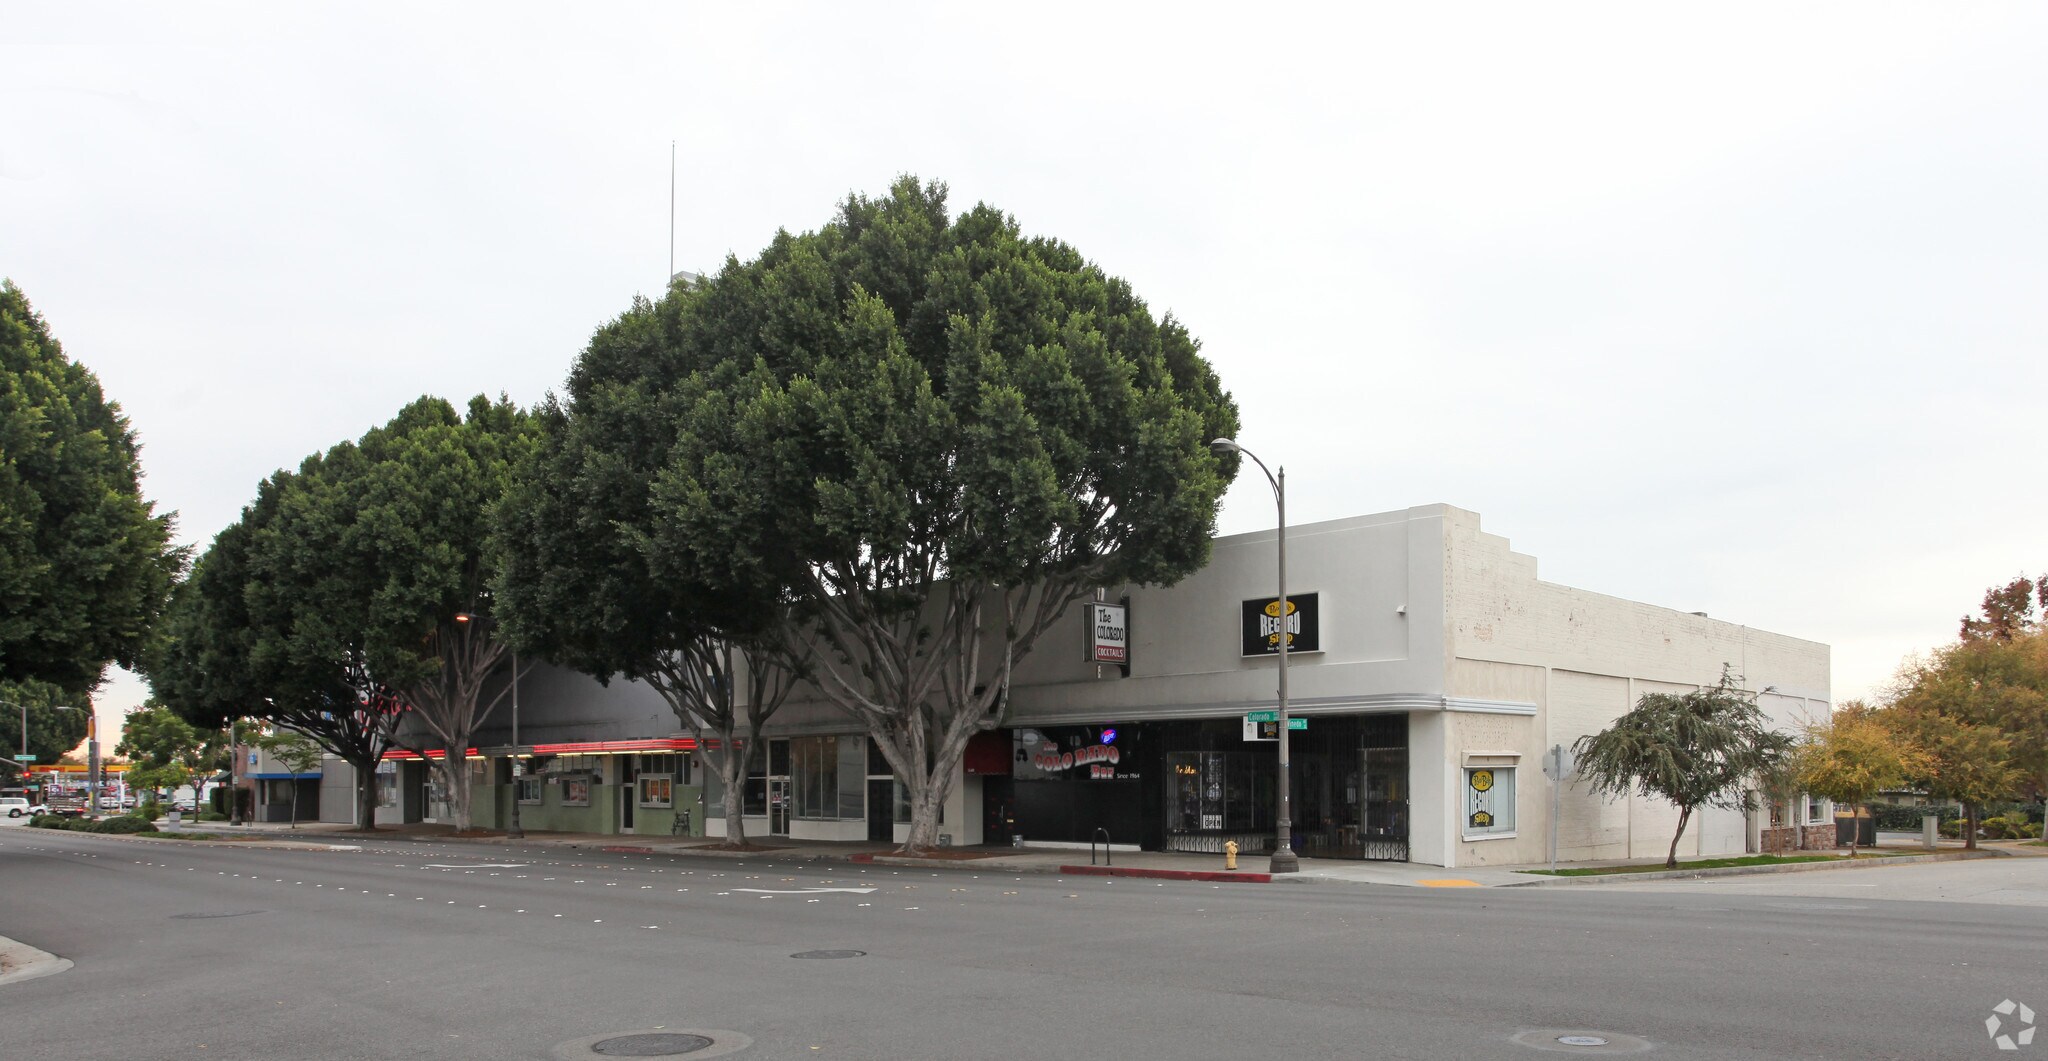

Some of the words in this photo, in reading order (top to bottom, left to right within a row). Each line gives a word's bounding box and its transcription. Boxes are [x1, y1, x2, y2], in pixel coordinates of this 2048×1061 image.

[1098, 608, 1112, 623] The
[1260, 610, 1300, 637] RECRD
[1097, 625, 1124, 641] COLORADO
[1269, 632, 1293, 646] Shp
[1097, 647, 1124, 658] COCKTAILS
[1249, 712, 1270, 721] Colorado
[1034, 744, 1120, 772] COLORADO
[1091, 764, 1115, 779] Bar
